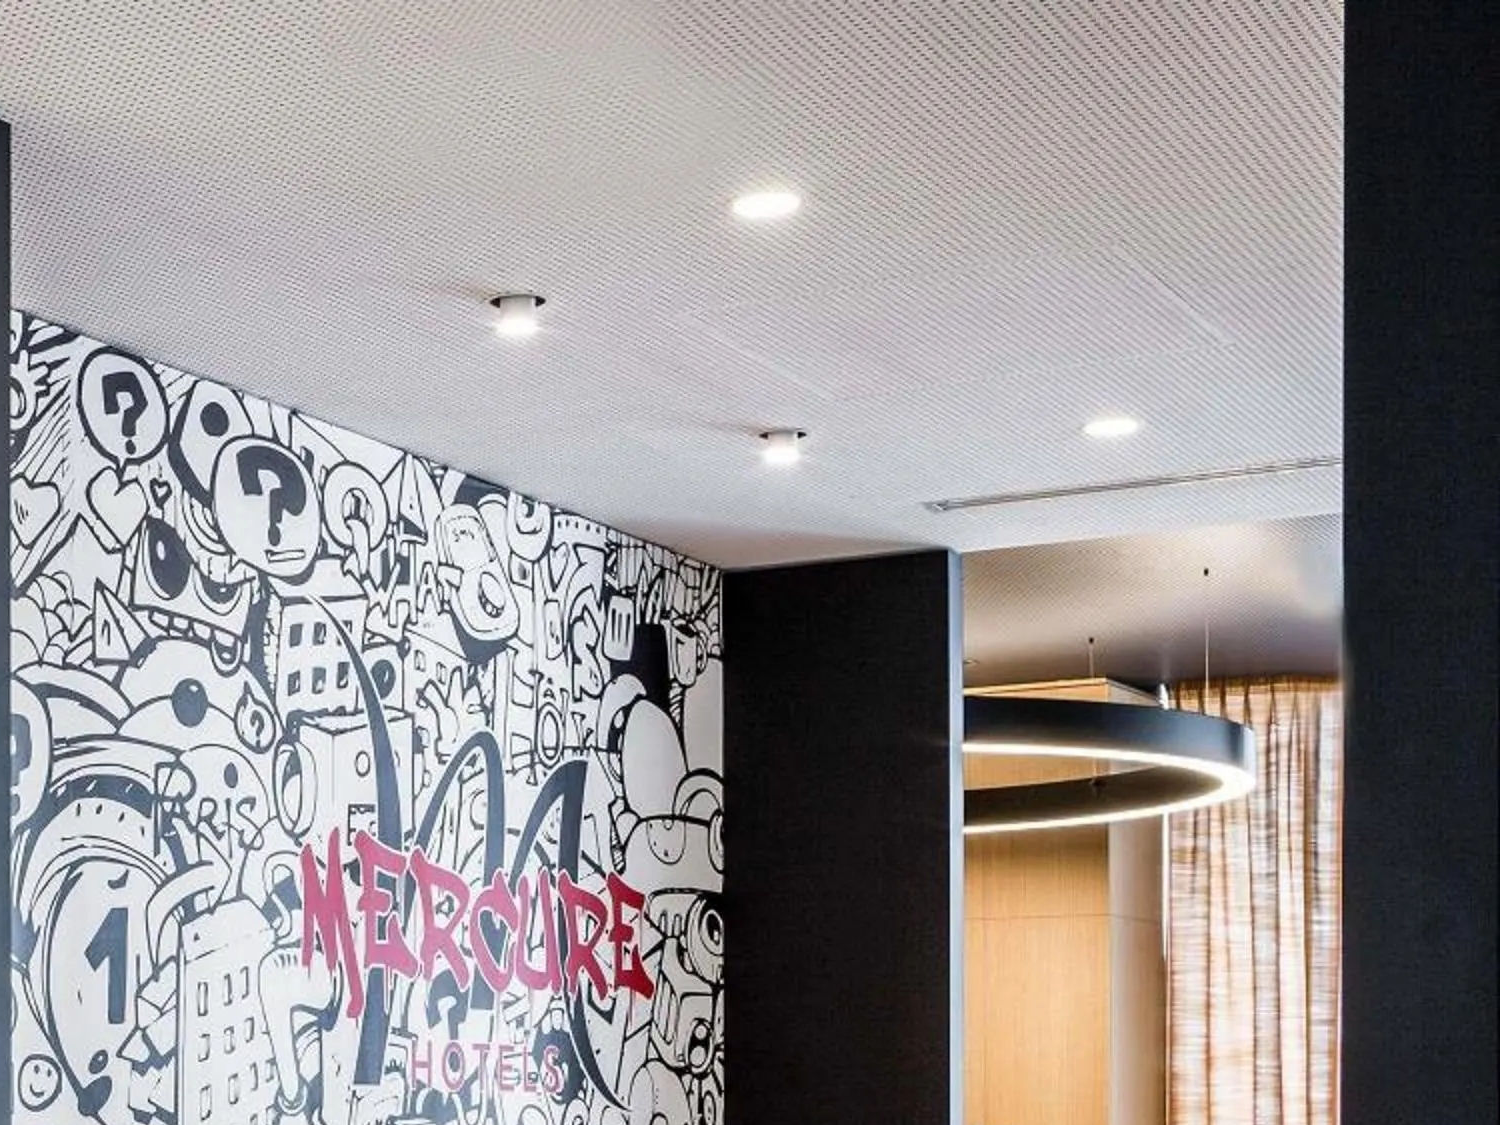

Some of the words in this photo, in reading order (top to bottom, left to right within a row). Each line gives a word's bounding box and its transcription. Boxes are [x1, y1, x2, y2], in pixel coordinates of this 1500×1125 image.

[101, 371, 148, 455] ?
[235, 445, 306, 546] ?
[153, 762, 264, 862] PARIS
[84, 907, 128, 1025] 1
[300, 827, 654, 1016] MERCURE
[411, 1040, 565, 1093] HOTELS
